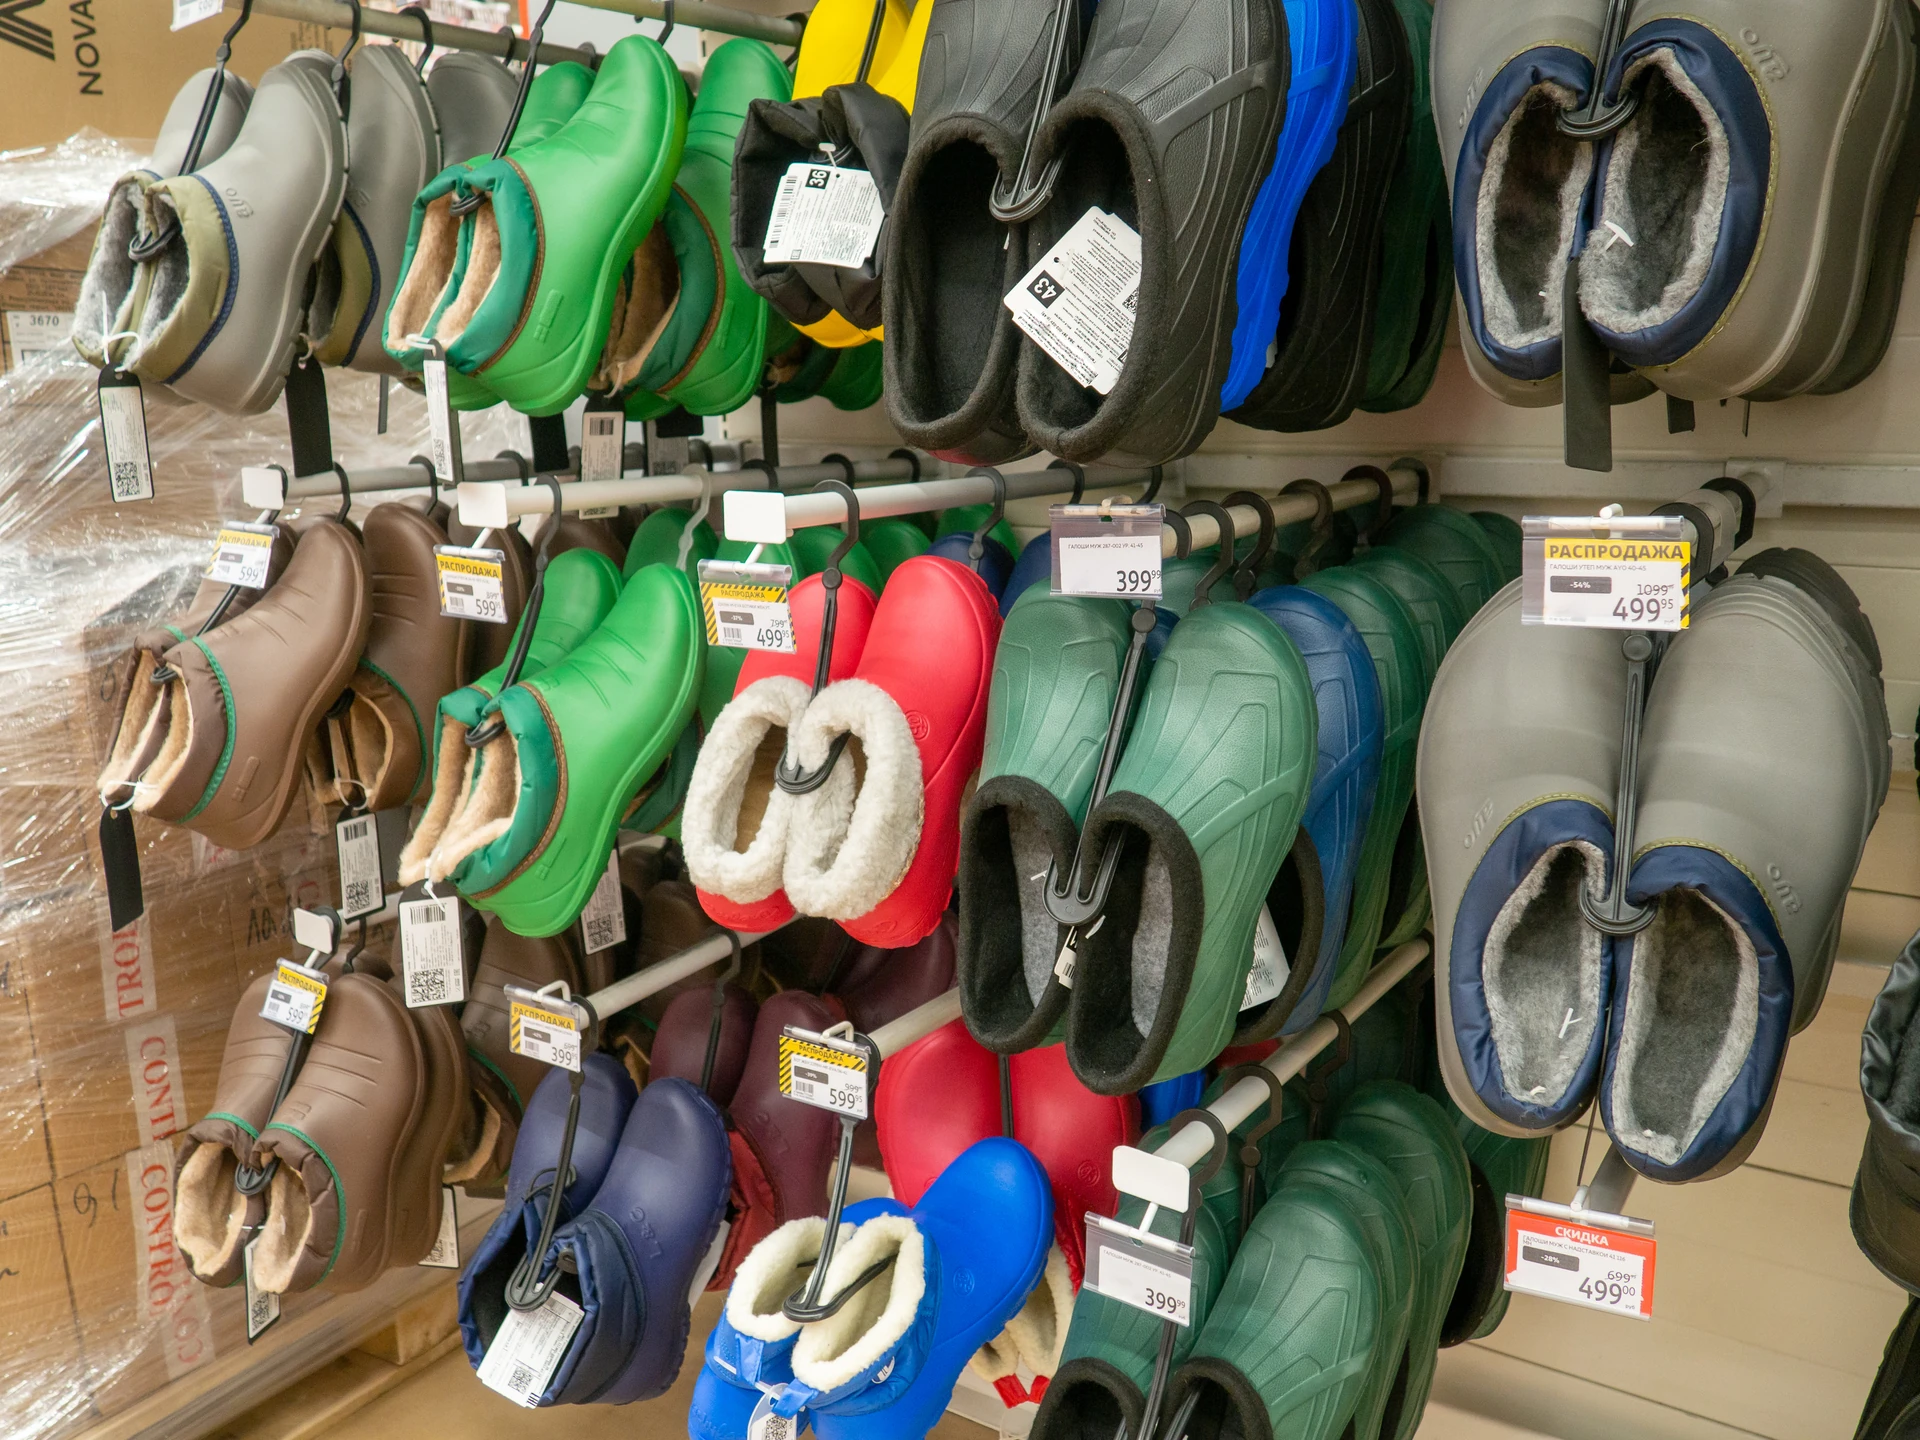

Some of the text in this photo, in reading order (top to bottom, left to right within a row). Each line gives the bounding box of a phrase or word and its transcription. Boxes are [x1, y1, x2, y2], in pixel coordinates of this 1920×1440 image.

[809, 169, 828, 187] 36
[1033, 277, 1058, 299] 43
[30, 315, 60, 326] 3670
[219, 535, 267, 548] РАСПРОДАЖА
[1550, 544, 1684, 561] РАСПРОДАЖА
[239, 566, 259, 582] 599
[440, 560, 499, 578] РАСПРОДАЖА
[1116, 570, 1161, 592] 399 99
[1569, 581, 1591, 589] -54%
[1637, 583, 1668, 596] 1099
[721, 589, 766, 599] РАСПРОДАЖА
[475, 598, 496, 617] 599
[1612, 597, 1674, 623] 499 95
[757, 628, 783, 648] 499
[280, 971, 323, 996] РАСПРОДАЖА
[286, 1007, 304, 1024] 599
[514, 1006, 572, 1030] РАСПРОДАЖА
[552, 1046, 572, 1066] 399
[799, 1044, 843, 1062] РАСПРОДАЖА
[829, 1088, 855, 1109] 599
[1522, 1234, 1548, 1245] ГАЛОШИ
[1548, 1240, 1563, 1249] МУЖ
[1555, 1226, 1609, 1246] СКИДКА
[1540, 1255, 1560, 1264] -28%
[1607, 1270, 1631, 1283] 699
[1578, 1277, 1636, 1305] 499 00
[1145, 1288, 1186, 1314] 399 99
